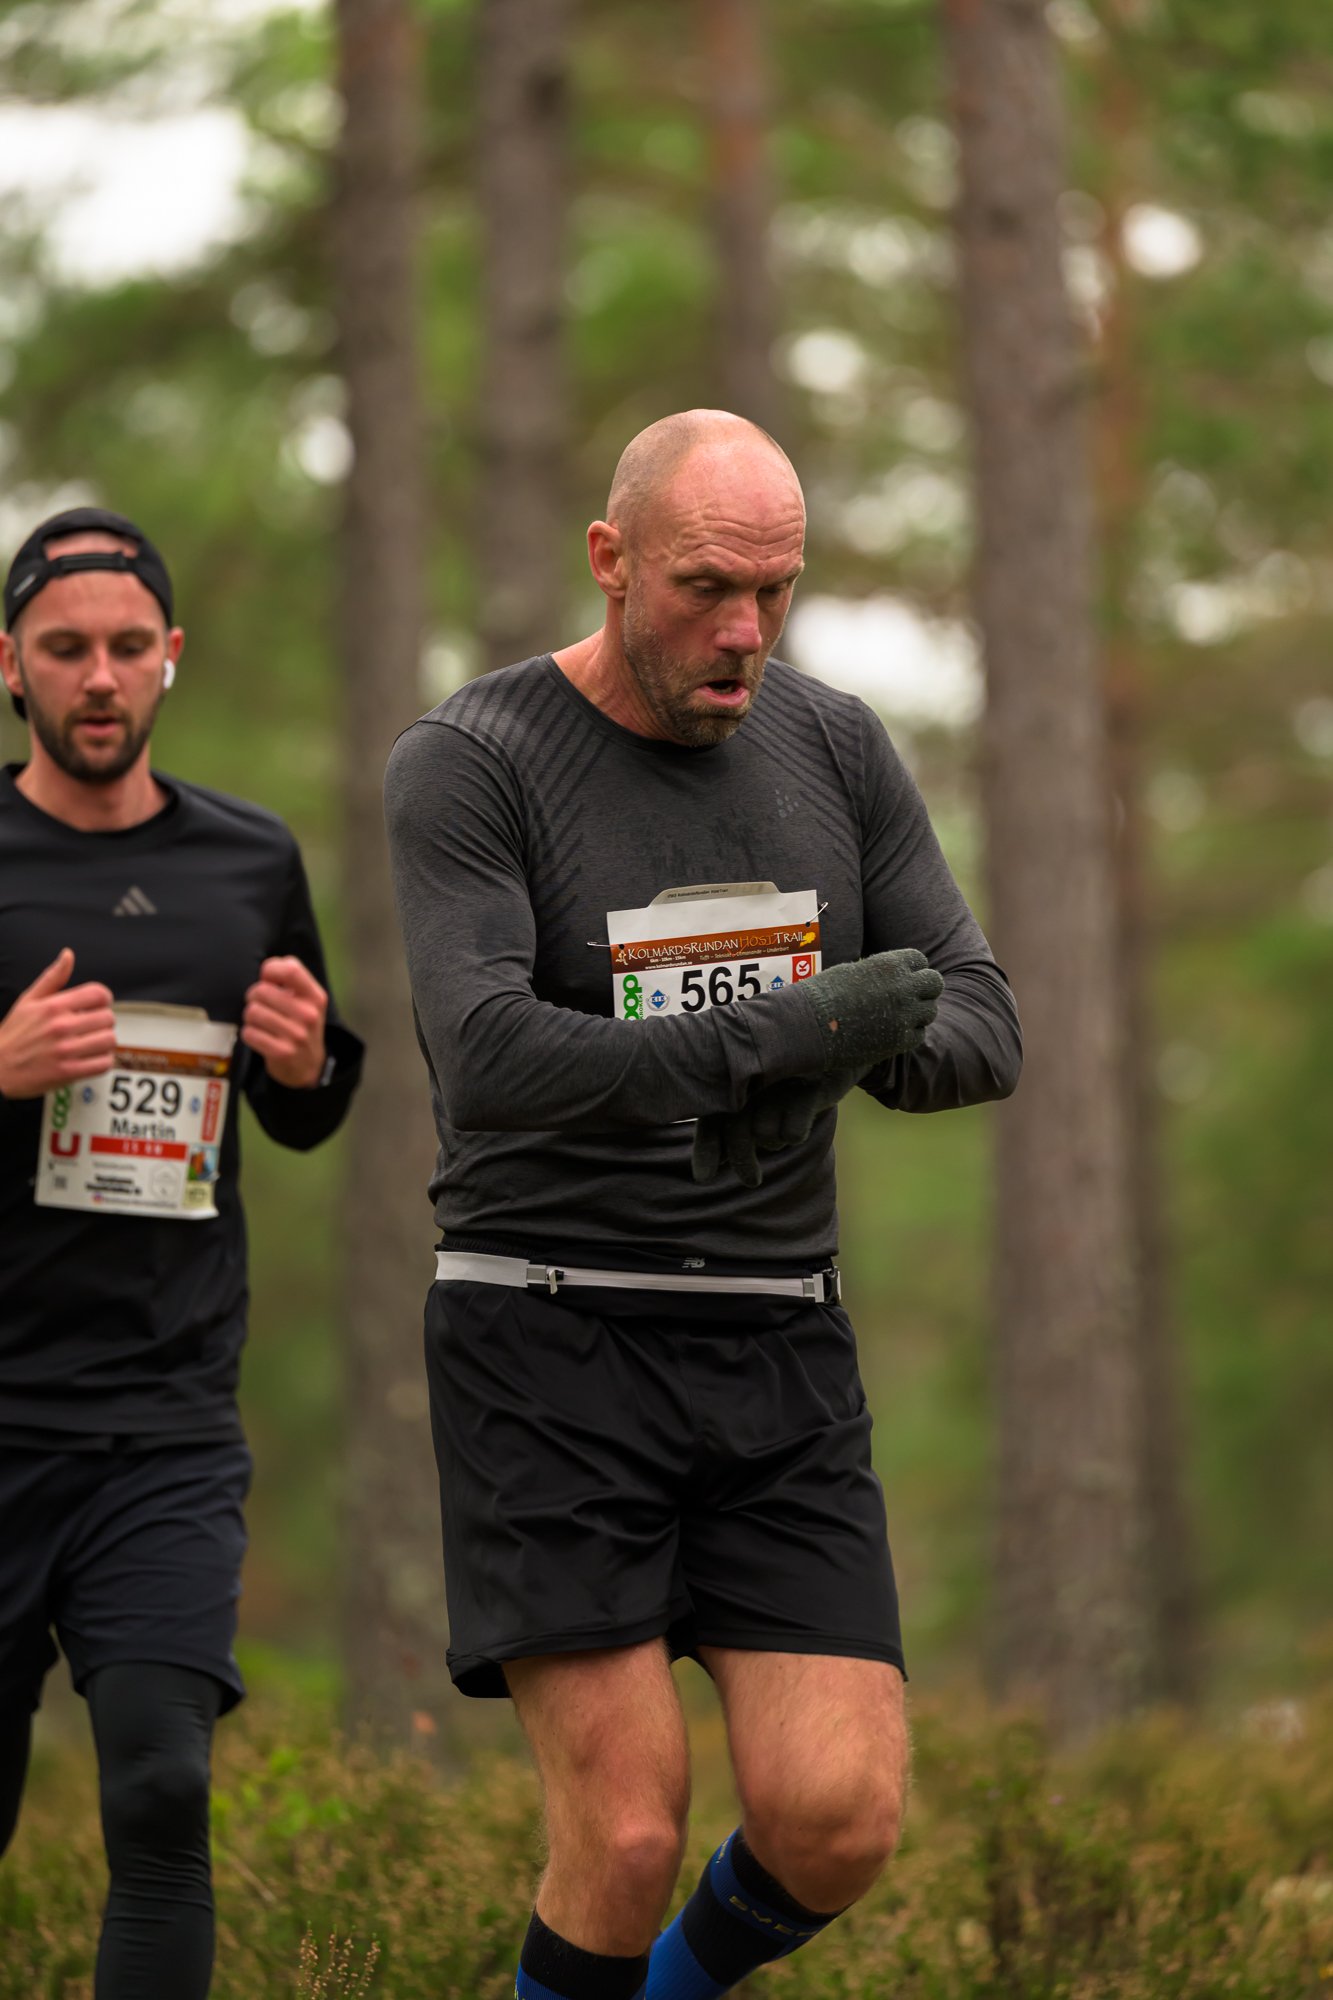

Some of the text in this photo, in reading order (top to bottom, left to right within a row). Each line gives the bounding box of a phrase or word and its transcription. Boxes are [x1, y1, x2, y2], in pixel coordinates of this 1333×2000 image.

[681, 963, 761, 1012] 565
[109, 1076, 182, 1118] 529
[111, 1118, 176, 1140] Martin
